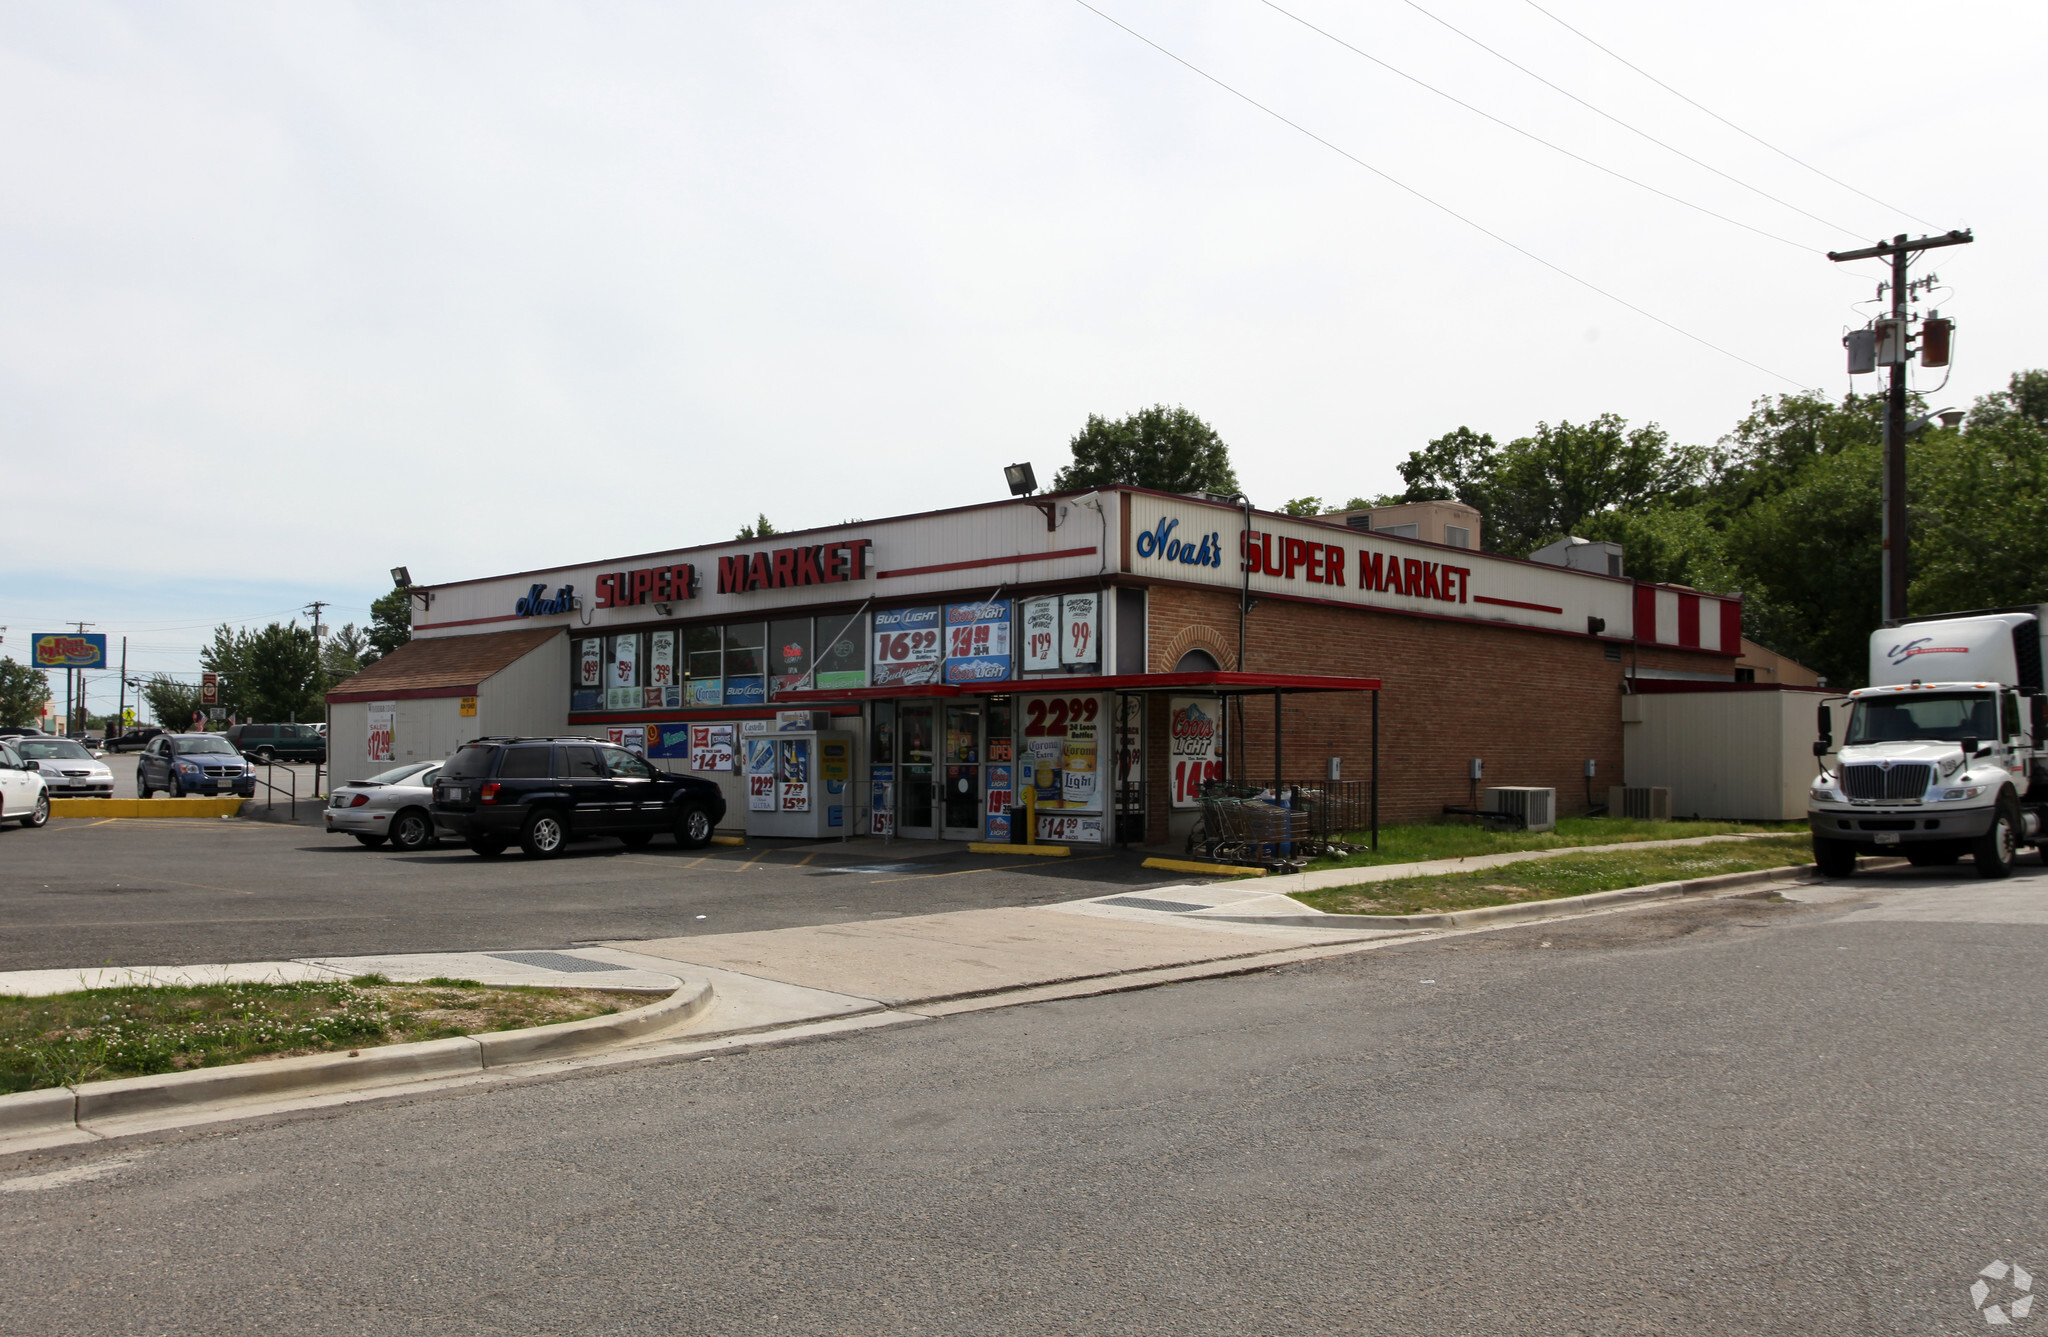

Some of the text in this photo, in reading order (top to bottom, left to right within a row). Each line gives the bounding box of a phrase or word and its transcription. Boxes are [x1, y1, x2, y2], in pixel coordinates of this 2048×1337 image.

[1138, 516, 1222, 568] Noah's
[596, 539, 872, 609] SUPER MARKET
[1240, 530, 1471, 604] SUPER MARKET
[516, 584, 573, 617] Noah's
[876, 612, 937, 624] BUD LIGHT
[976, 608, 1005, 619] LIGHT
[976, 668, 1006, 678] LIGHT
[726, 687, 764, 695] BUD LIGH
[1172, 710, 1214, 738] Coors
[1029, 741, 1058, 752] Corona
[1173, 740, 1212, 755] LIGHT
[1064, 772, 1092, 788] Light
